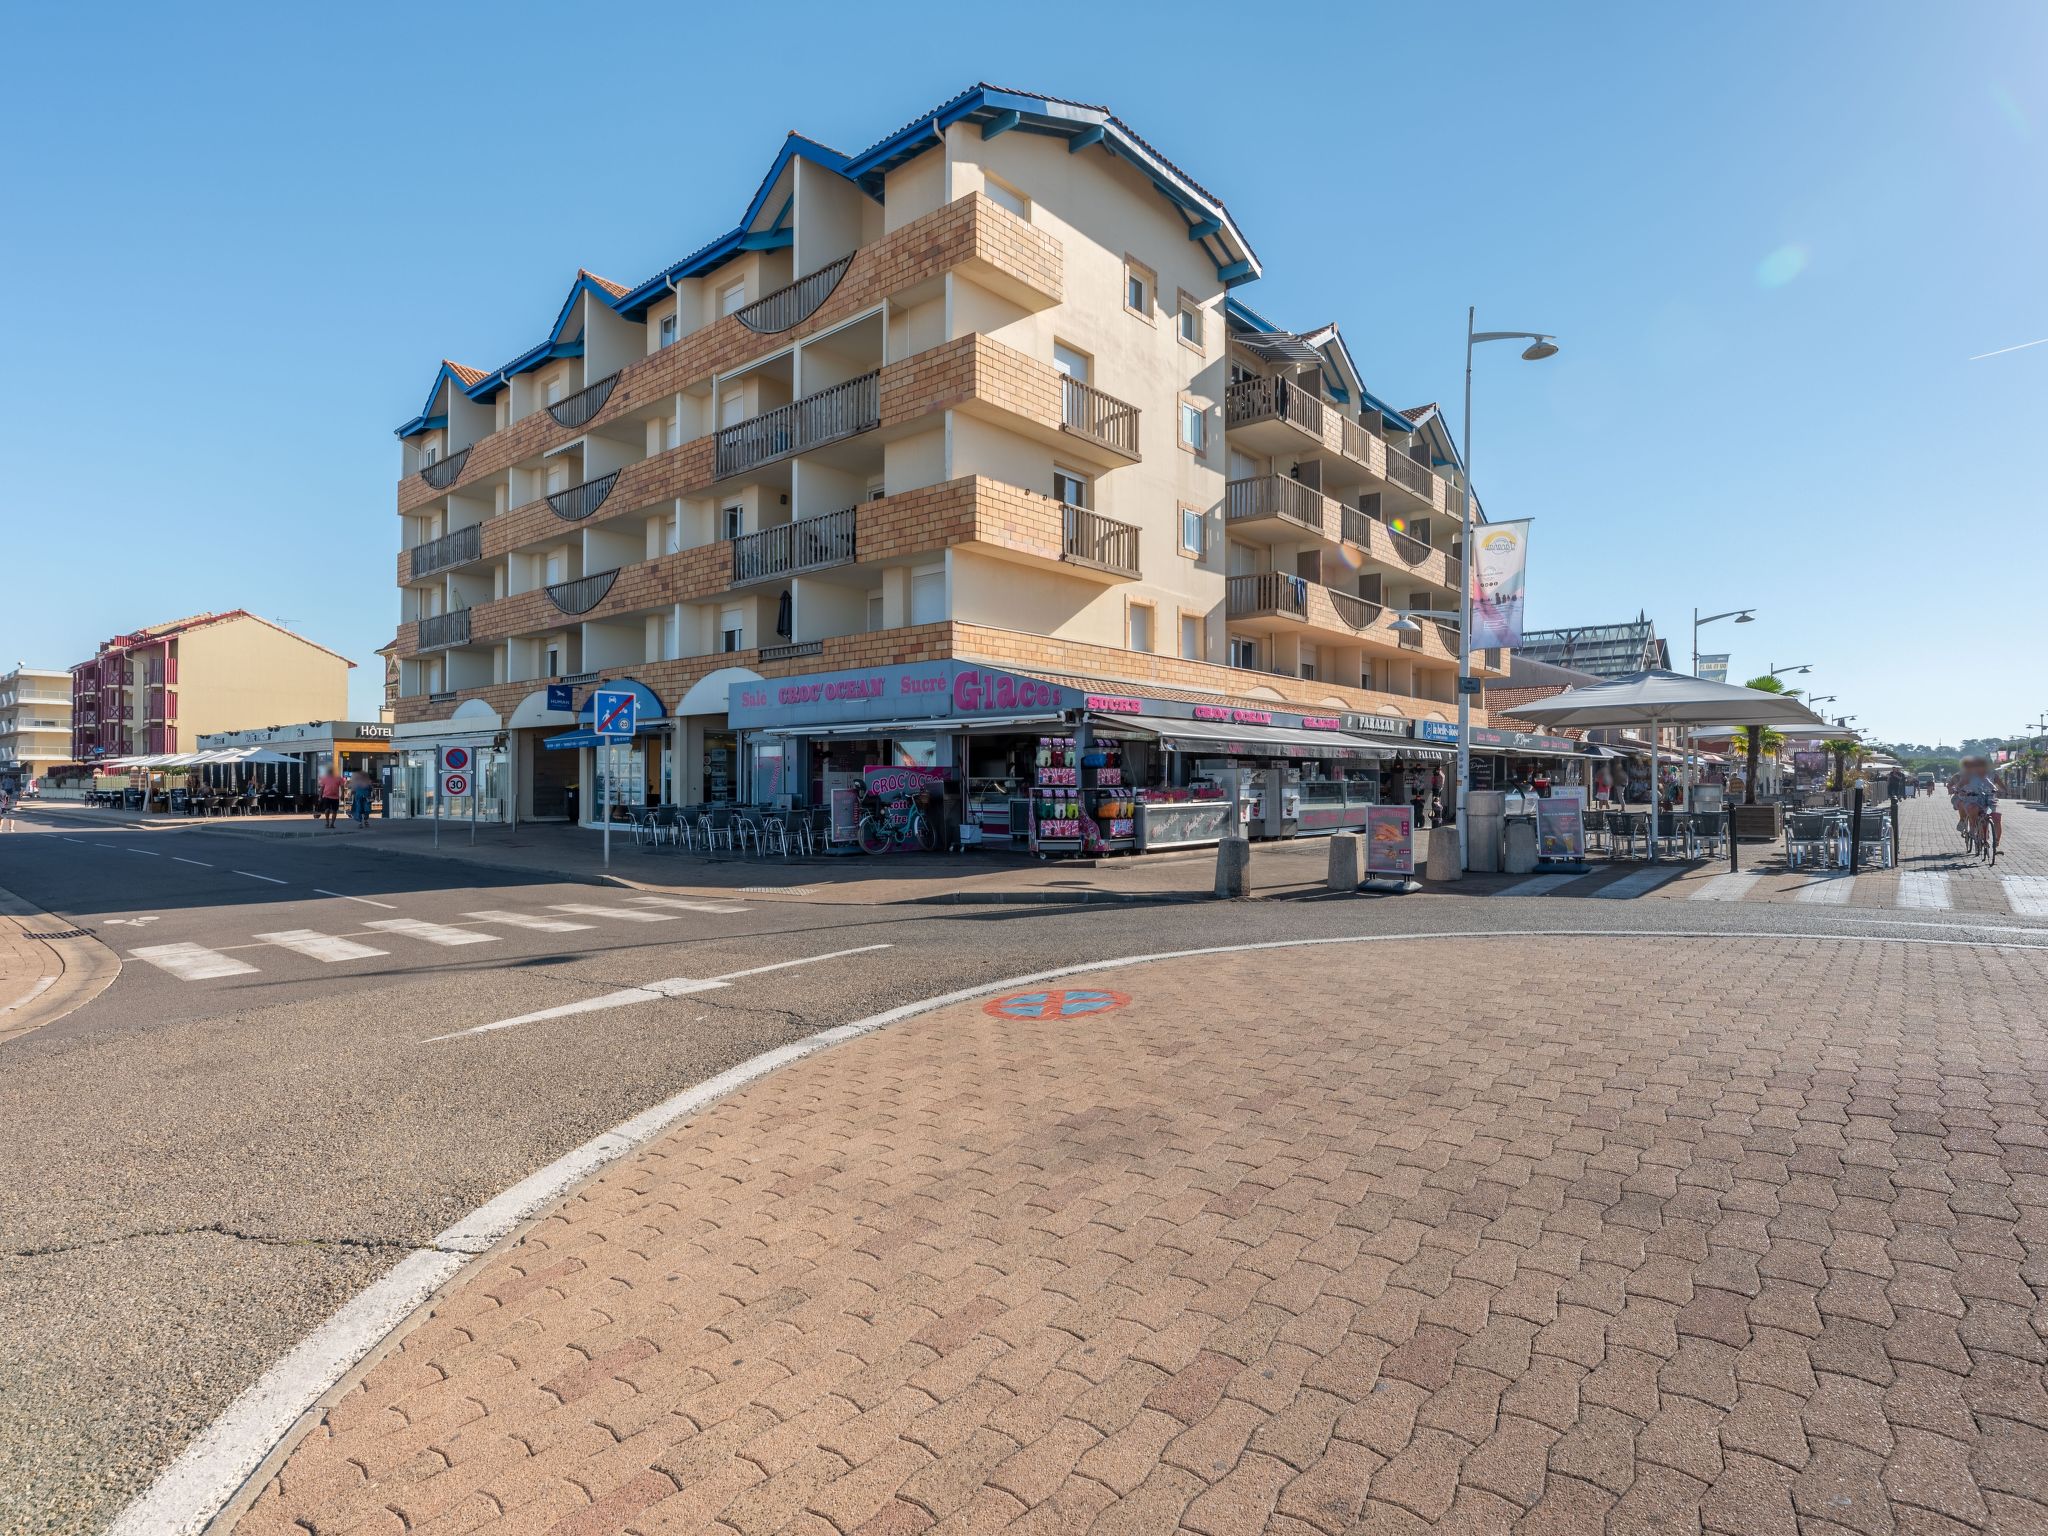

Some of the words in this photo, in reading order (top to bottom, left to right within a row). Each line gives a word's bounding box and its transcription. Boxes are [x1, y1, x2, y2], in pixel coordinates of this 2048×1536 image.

[825, 677, 885, 701] OCEAN
[901, 671, 947, 694] Sucré
[953, 669, 1061, 711] Glaces
[361, 725, 394, 736] HÔTEL
[1359, 716, 1395, 730] PARAZAR
[450, 780, 463, 790] 30
